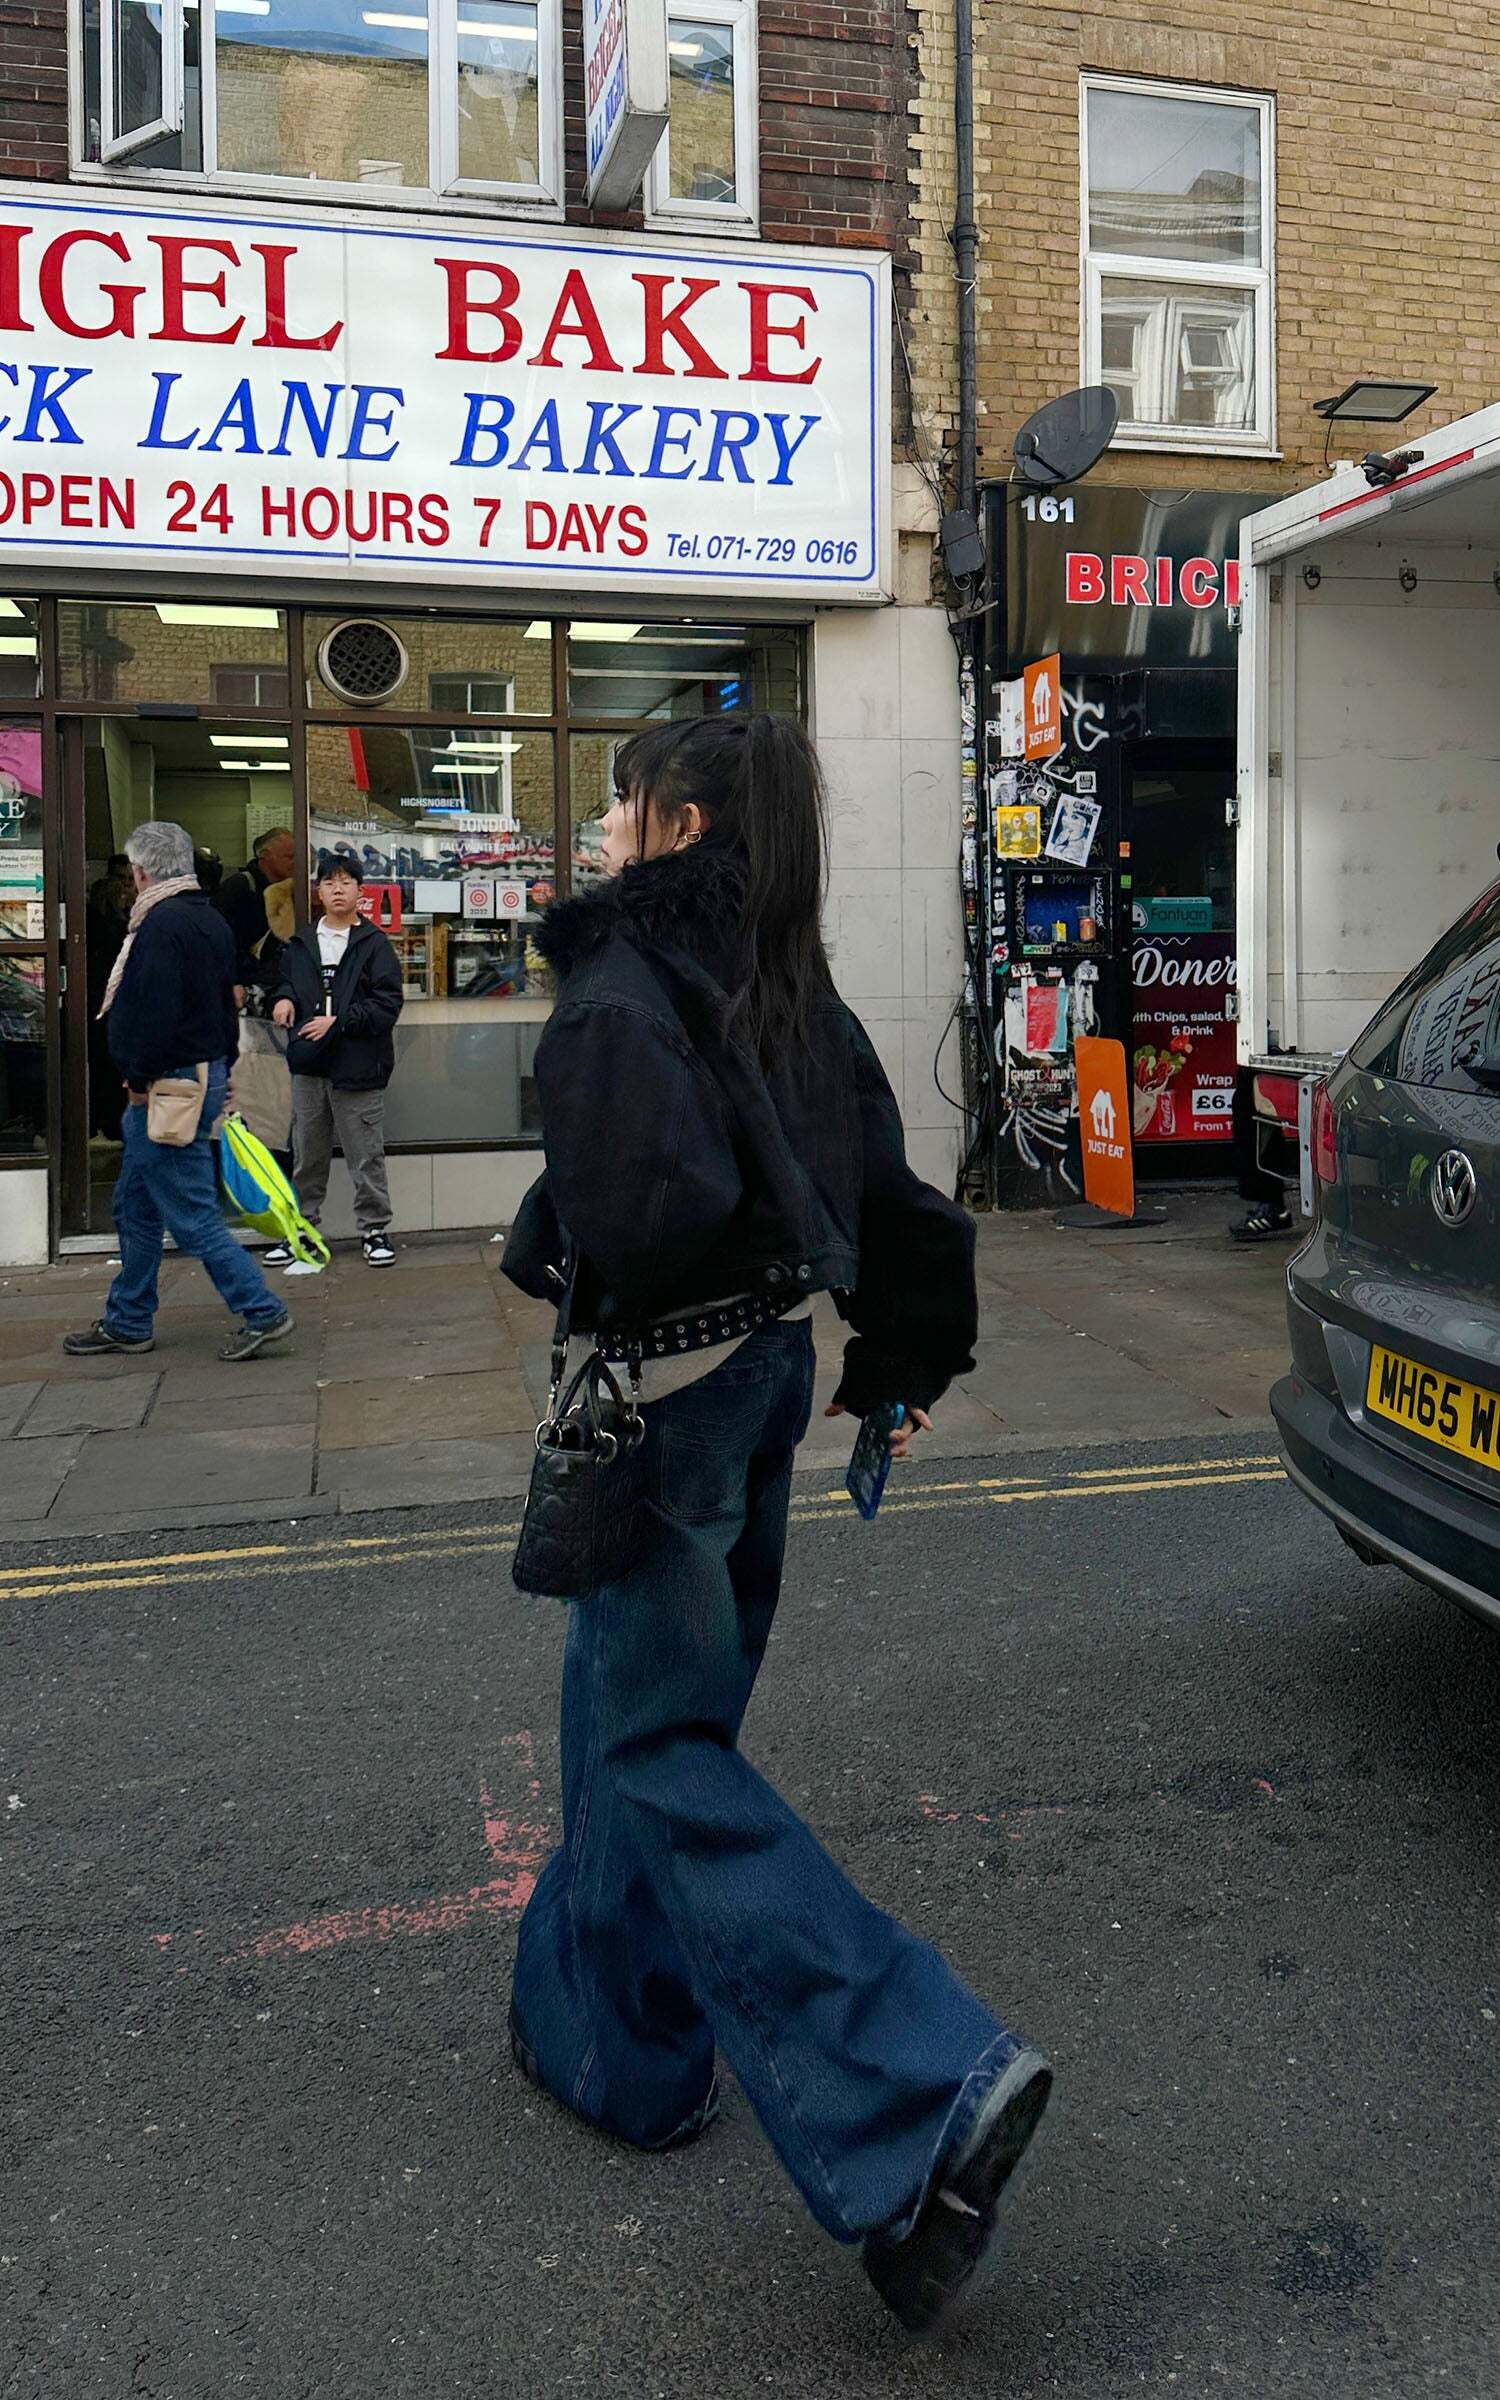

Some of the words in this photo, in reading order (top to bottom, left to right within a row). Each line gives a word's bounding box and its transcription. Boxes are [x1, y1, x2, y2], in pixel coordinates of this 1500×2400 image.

[434, 258, 822, 385] BAKE
[0, 360, 92, 445] K
[137, 372, 405, 462] LANE
[451, 393, 822, 486] BAKERY
[166, 480, 233, 534] 24
[262, 486, 450, 547] HOURS
[473, 497, 502, 548] 7
[525, 501, 649, 558] DAYS
[1021, 496, 1075, 524] 161
[706, 535, 796, 562] 071-729
[806, 540, 858, 565] 0616
[1028, 732, 1044, 749] JUST
[1044, 726, 1057, 743] EAT
[400, 797, 465, 808] HIGHSNOBIETY
[345, 822, 366, 831] NOT
[459, 818, 521, 833] LONDON
[1151, 908, 1208, 922] Fantuan
[1132, 947, 1237, 987] Doner
[1154, 1011, 1189, 1023] Chips,
[1190, 1011, 1224, 1022] salad,
[1171, 1026, 1180, 1036] &
[1183, 1025, 1214, 1036] Drink
[1010, 1069, 1041, 1081] GHOST
[1196, 1073, 1233, 1087] Wrap
[1193, 1121, 1223, 1132] From
[1087, 1138, 1107, 1156] JUST
[1107, 1141, 1125, 1160] EAT
[1379, 1353, 1462, 1438] MH65
[1470, 1392, 1500, 1457] W
